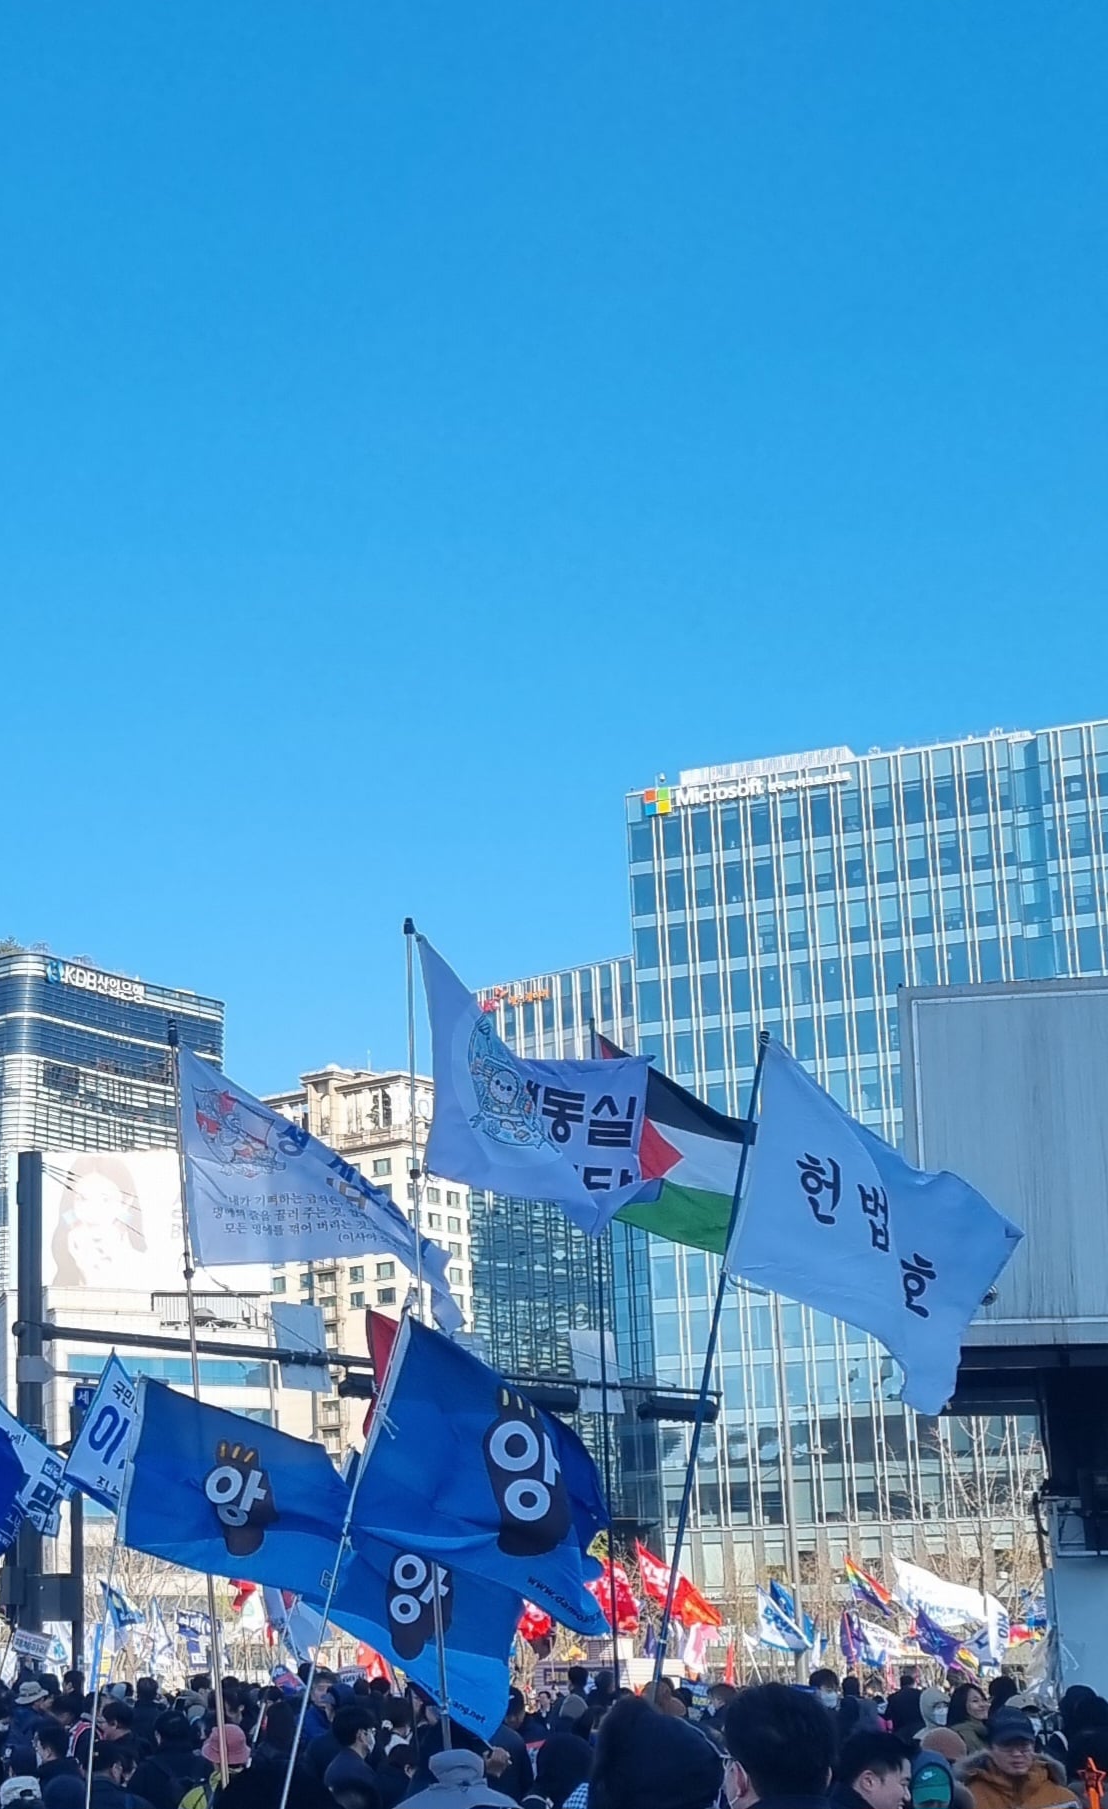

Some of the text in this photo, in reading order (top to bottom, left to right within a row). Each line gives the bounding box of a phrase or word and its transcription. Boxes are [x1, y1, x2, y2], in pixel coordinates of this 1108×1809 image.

[676, 778, 765, 807] Microsoft
[88, 1404, 131, 1466] 이
[205, 1465, 268, 1527] 앙
[489, 1420, 562, 1521] 앙
[390, 1554, 450, 1624] 앙
